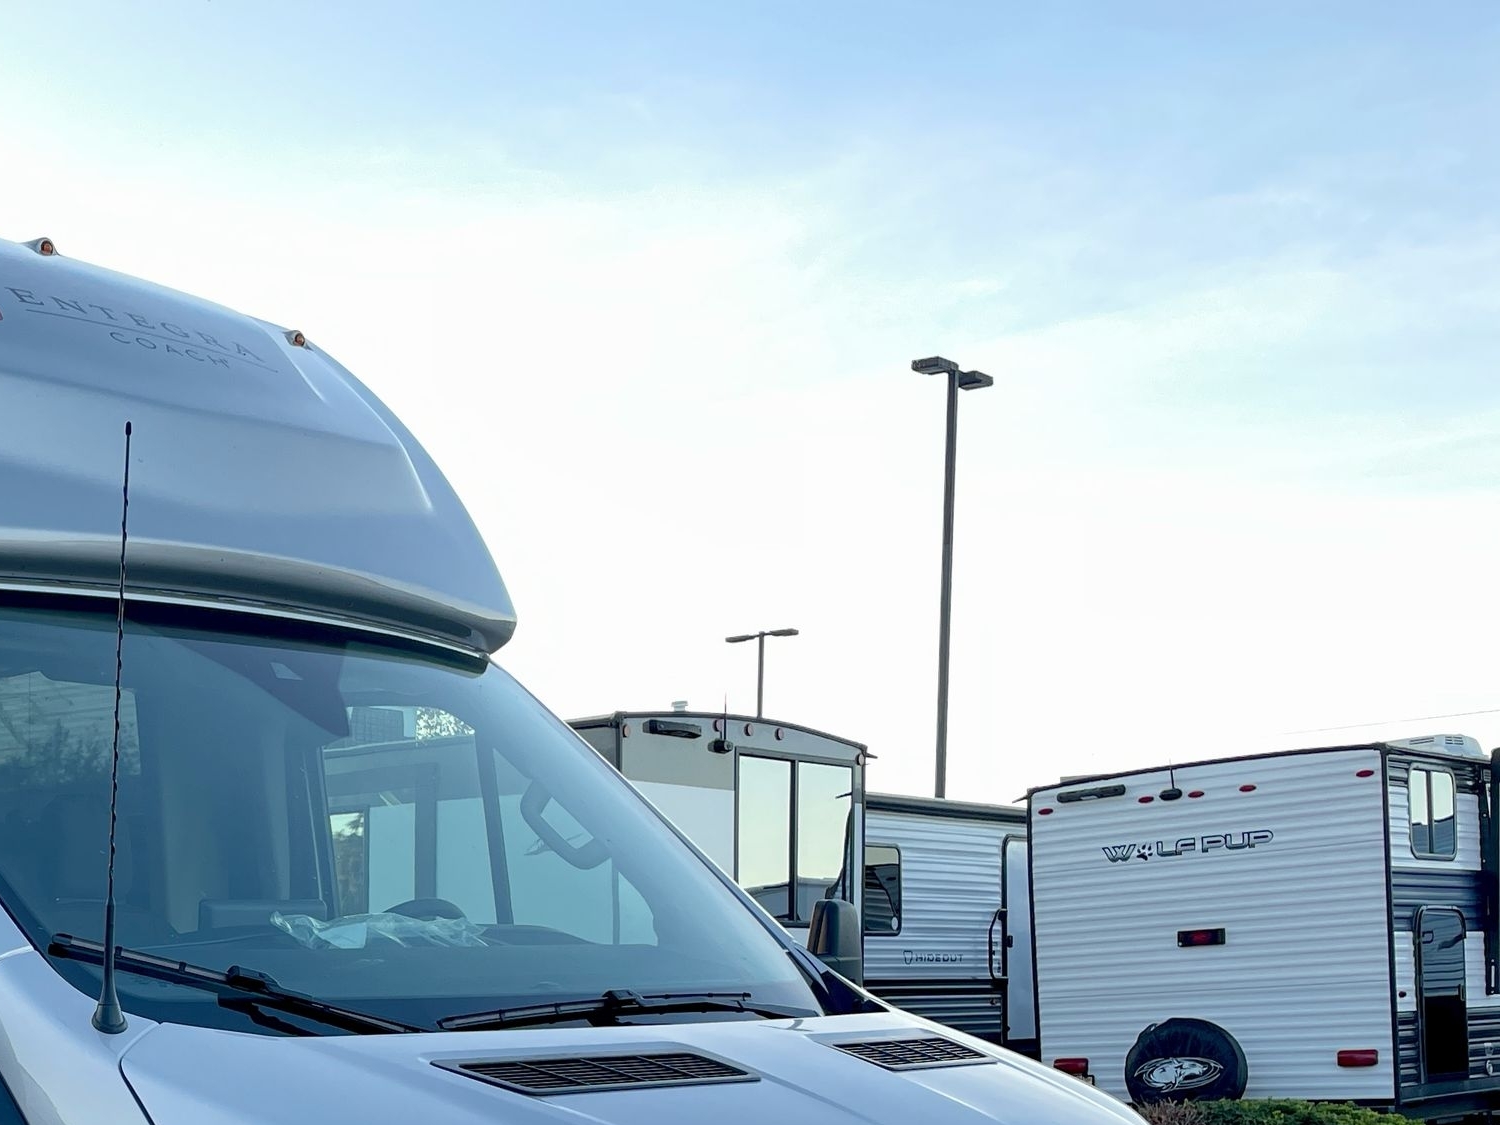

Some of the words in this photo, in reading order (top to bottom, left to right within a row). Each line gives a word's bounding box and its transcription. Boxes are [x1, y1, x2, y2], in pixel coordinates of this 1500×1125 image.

[4, 286, 264, 362] ENTEGRA
[109, 331, 230, 369] COACH
[1201, 829, 1274, 853] PUP
